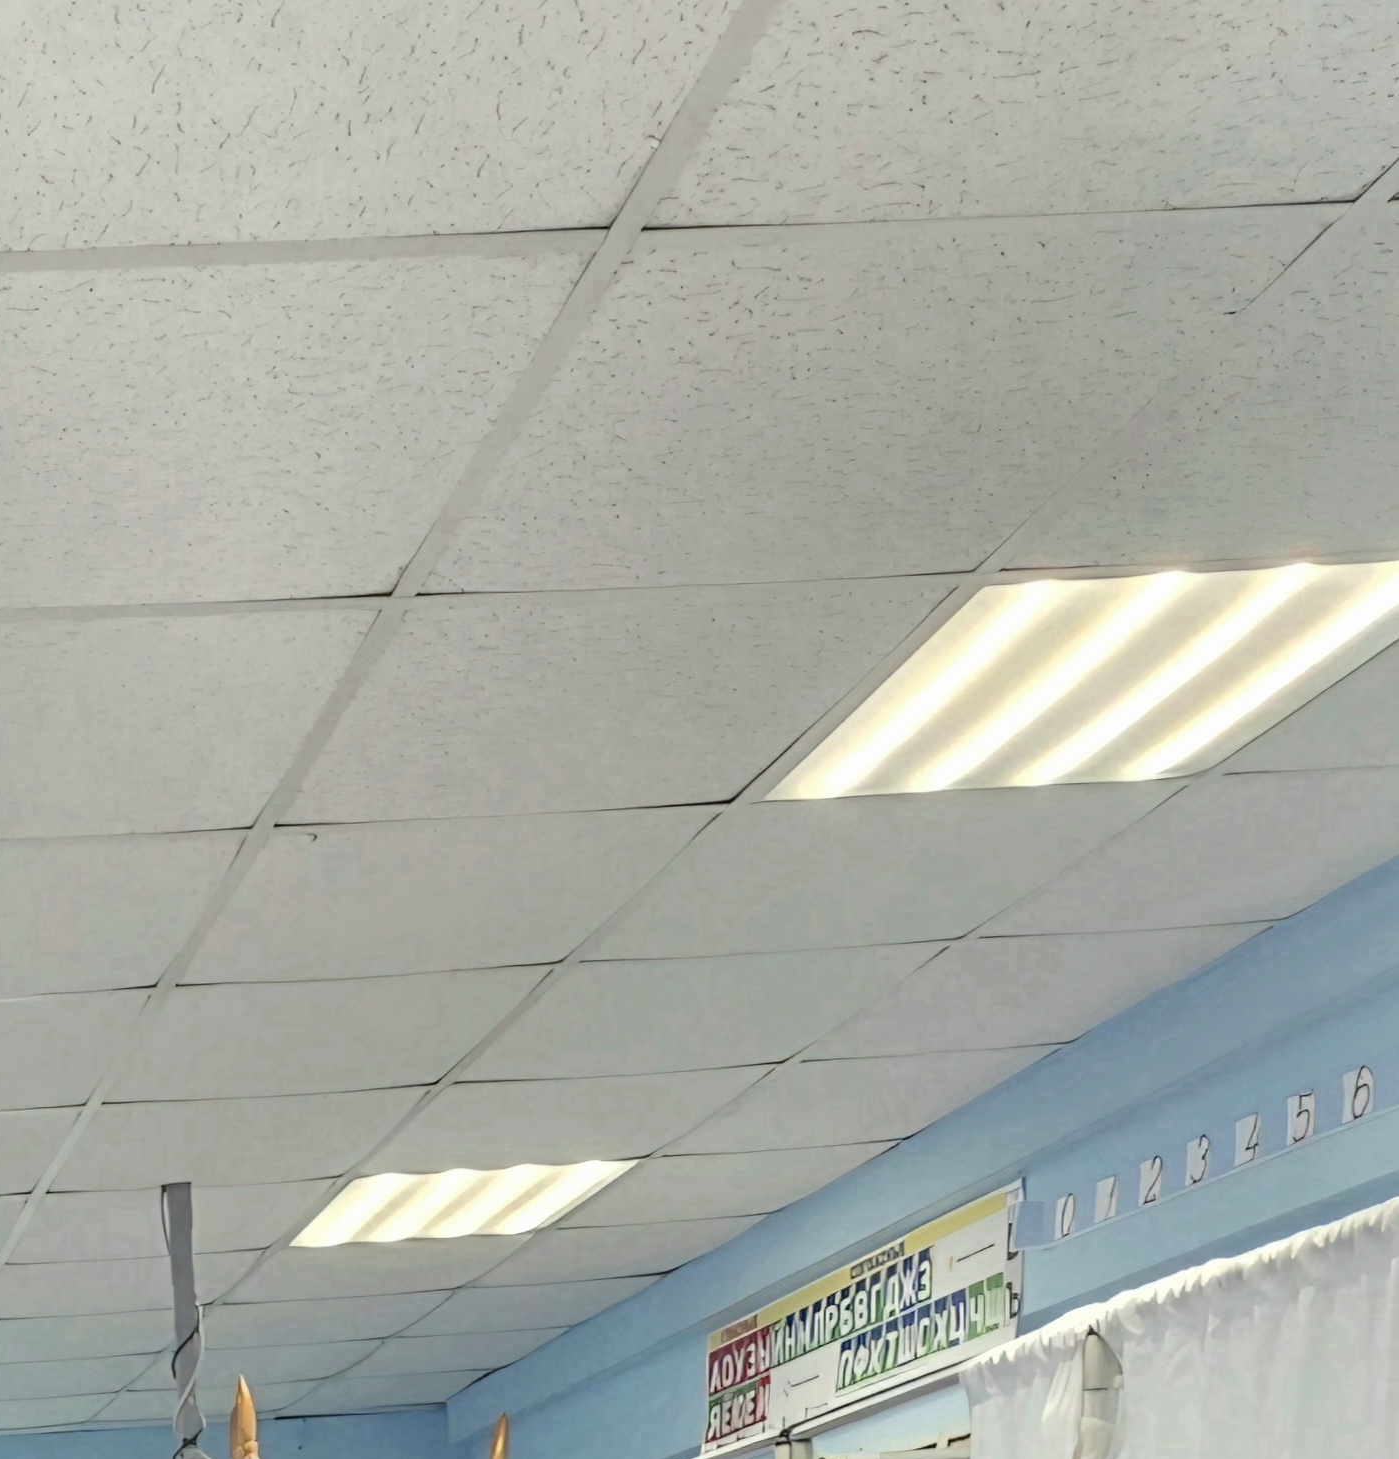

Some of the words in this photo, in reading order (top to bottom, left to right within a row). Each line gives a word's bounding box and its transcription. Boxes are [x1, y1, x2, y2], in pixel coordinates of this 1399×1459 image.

[1061, 1193, 1075, 1237] 0
[1143, 1156, 1163, 1205] 2
[1190, 1135, 1211, 1183] 3
[1245, 1112, 1259, 1160] 4
[1293, 1089, 1314, 1143] 5
[1352, 1065, 1374, 1119] 6
